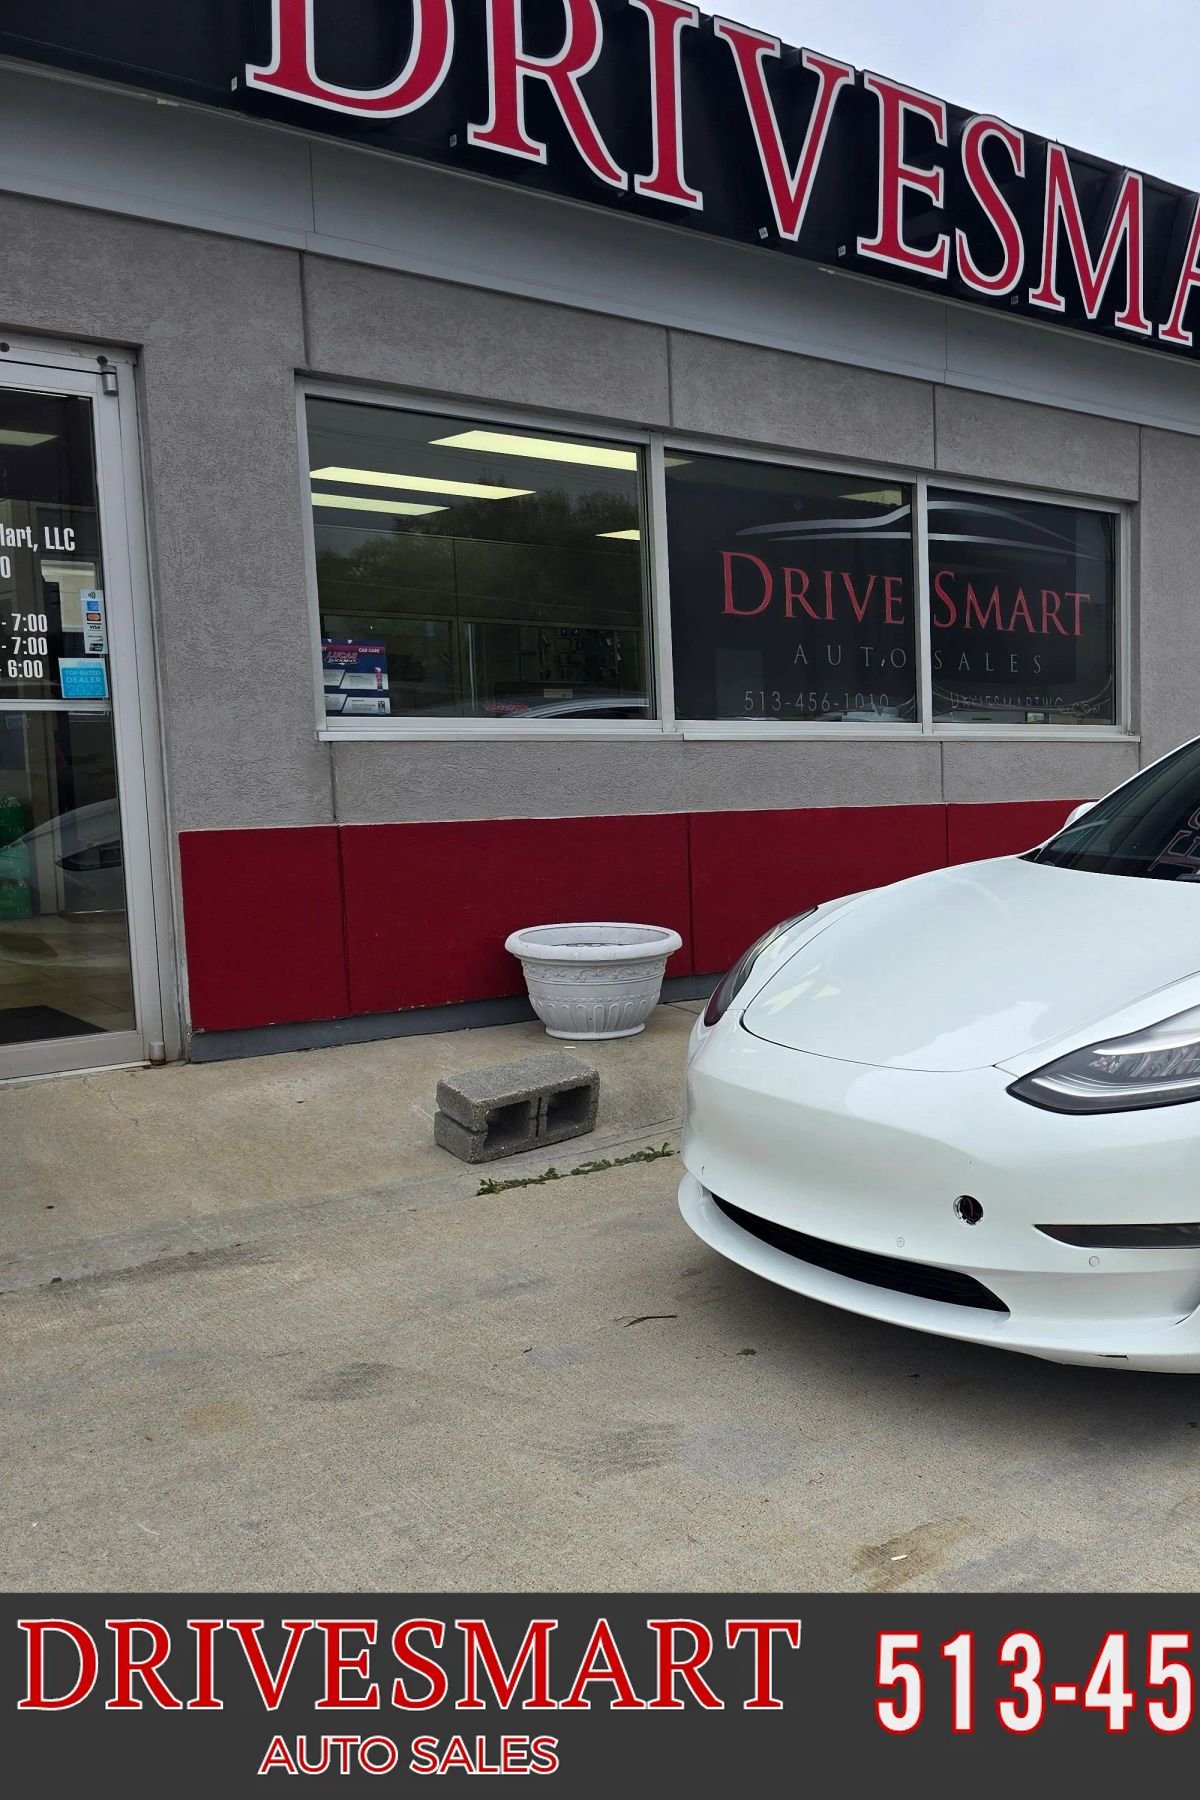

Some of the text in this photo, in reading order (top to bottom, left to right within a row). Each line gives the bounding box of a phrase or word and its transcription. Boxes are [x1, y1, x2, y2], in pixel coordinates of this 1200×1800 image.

[44, 526, 76, 551] LLC
[11, 613, 48, 633] 7:00
[11, 636, 48, 656] 7:00
[793, 642, 1042, 674] AUTO SALES
[7, 659, 44, 678] 6:00
